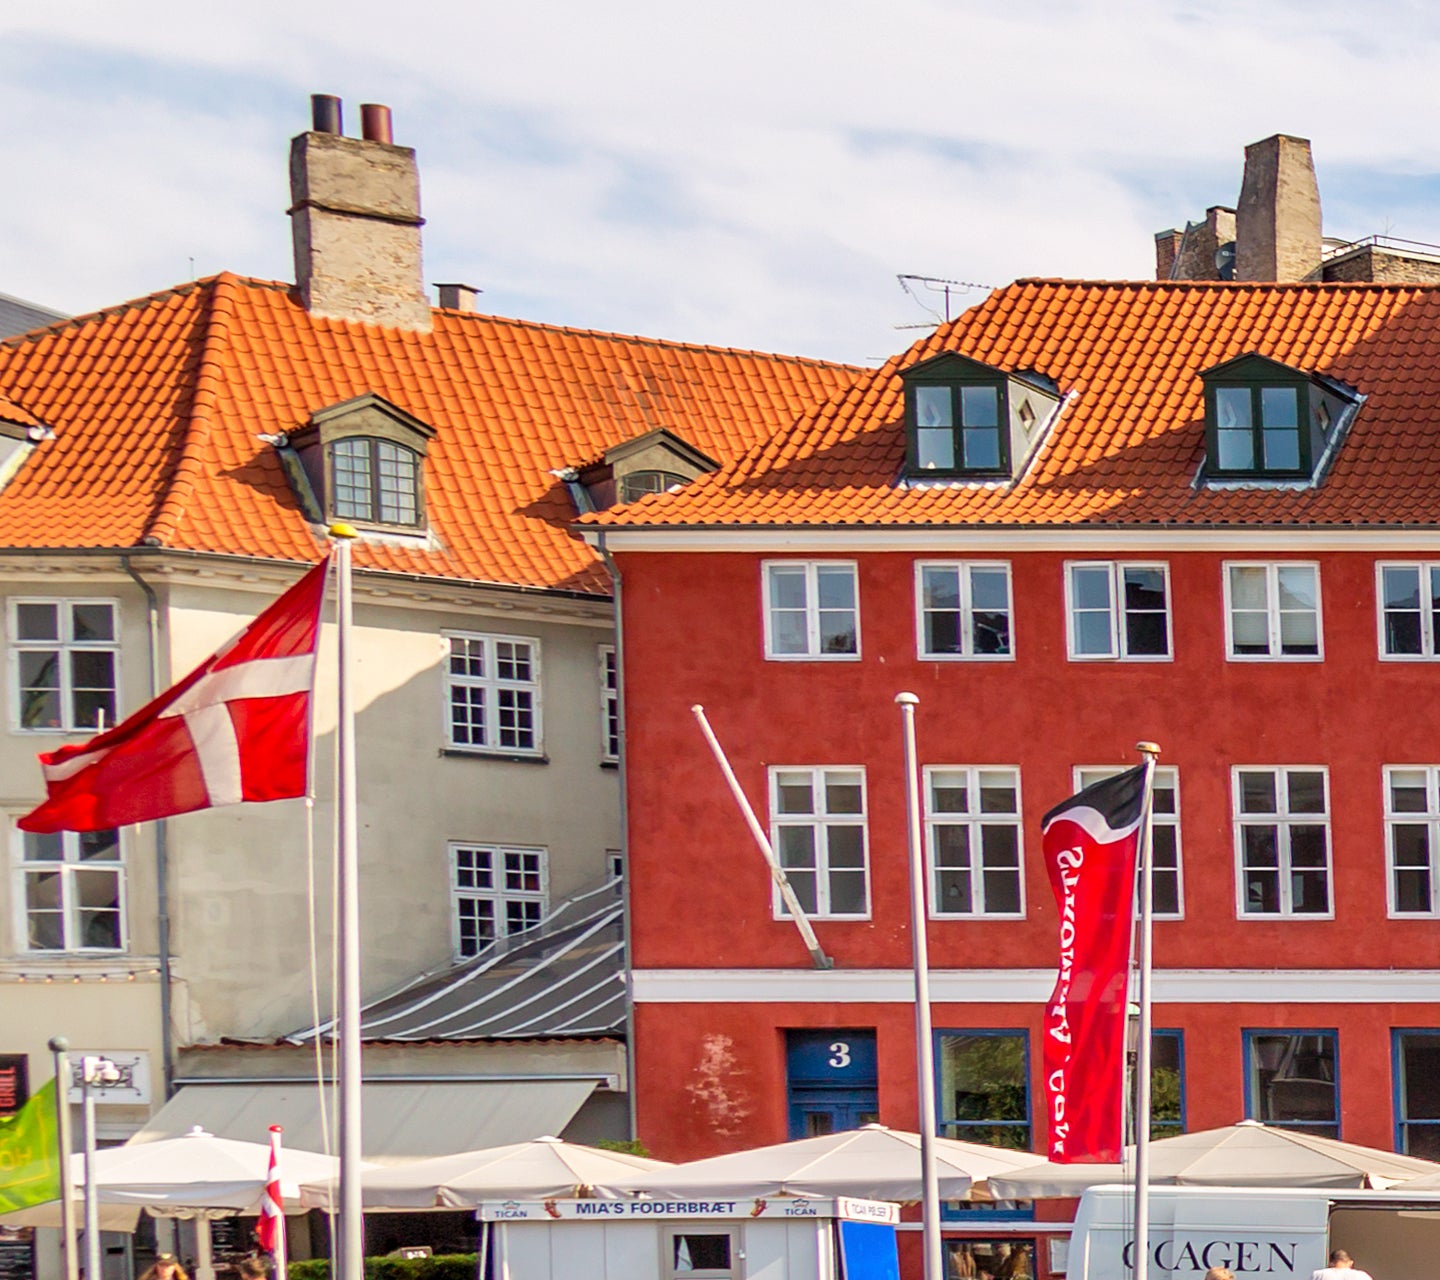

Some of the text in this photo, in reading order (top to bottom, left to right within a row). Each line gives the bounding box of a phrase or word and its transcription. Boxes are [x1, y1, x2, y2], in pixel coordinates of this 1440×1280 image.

[829, 1042, 851, 1068] 3
[576, 1202, 736, 1214] MIA'S FODERBRÆT
